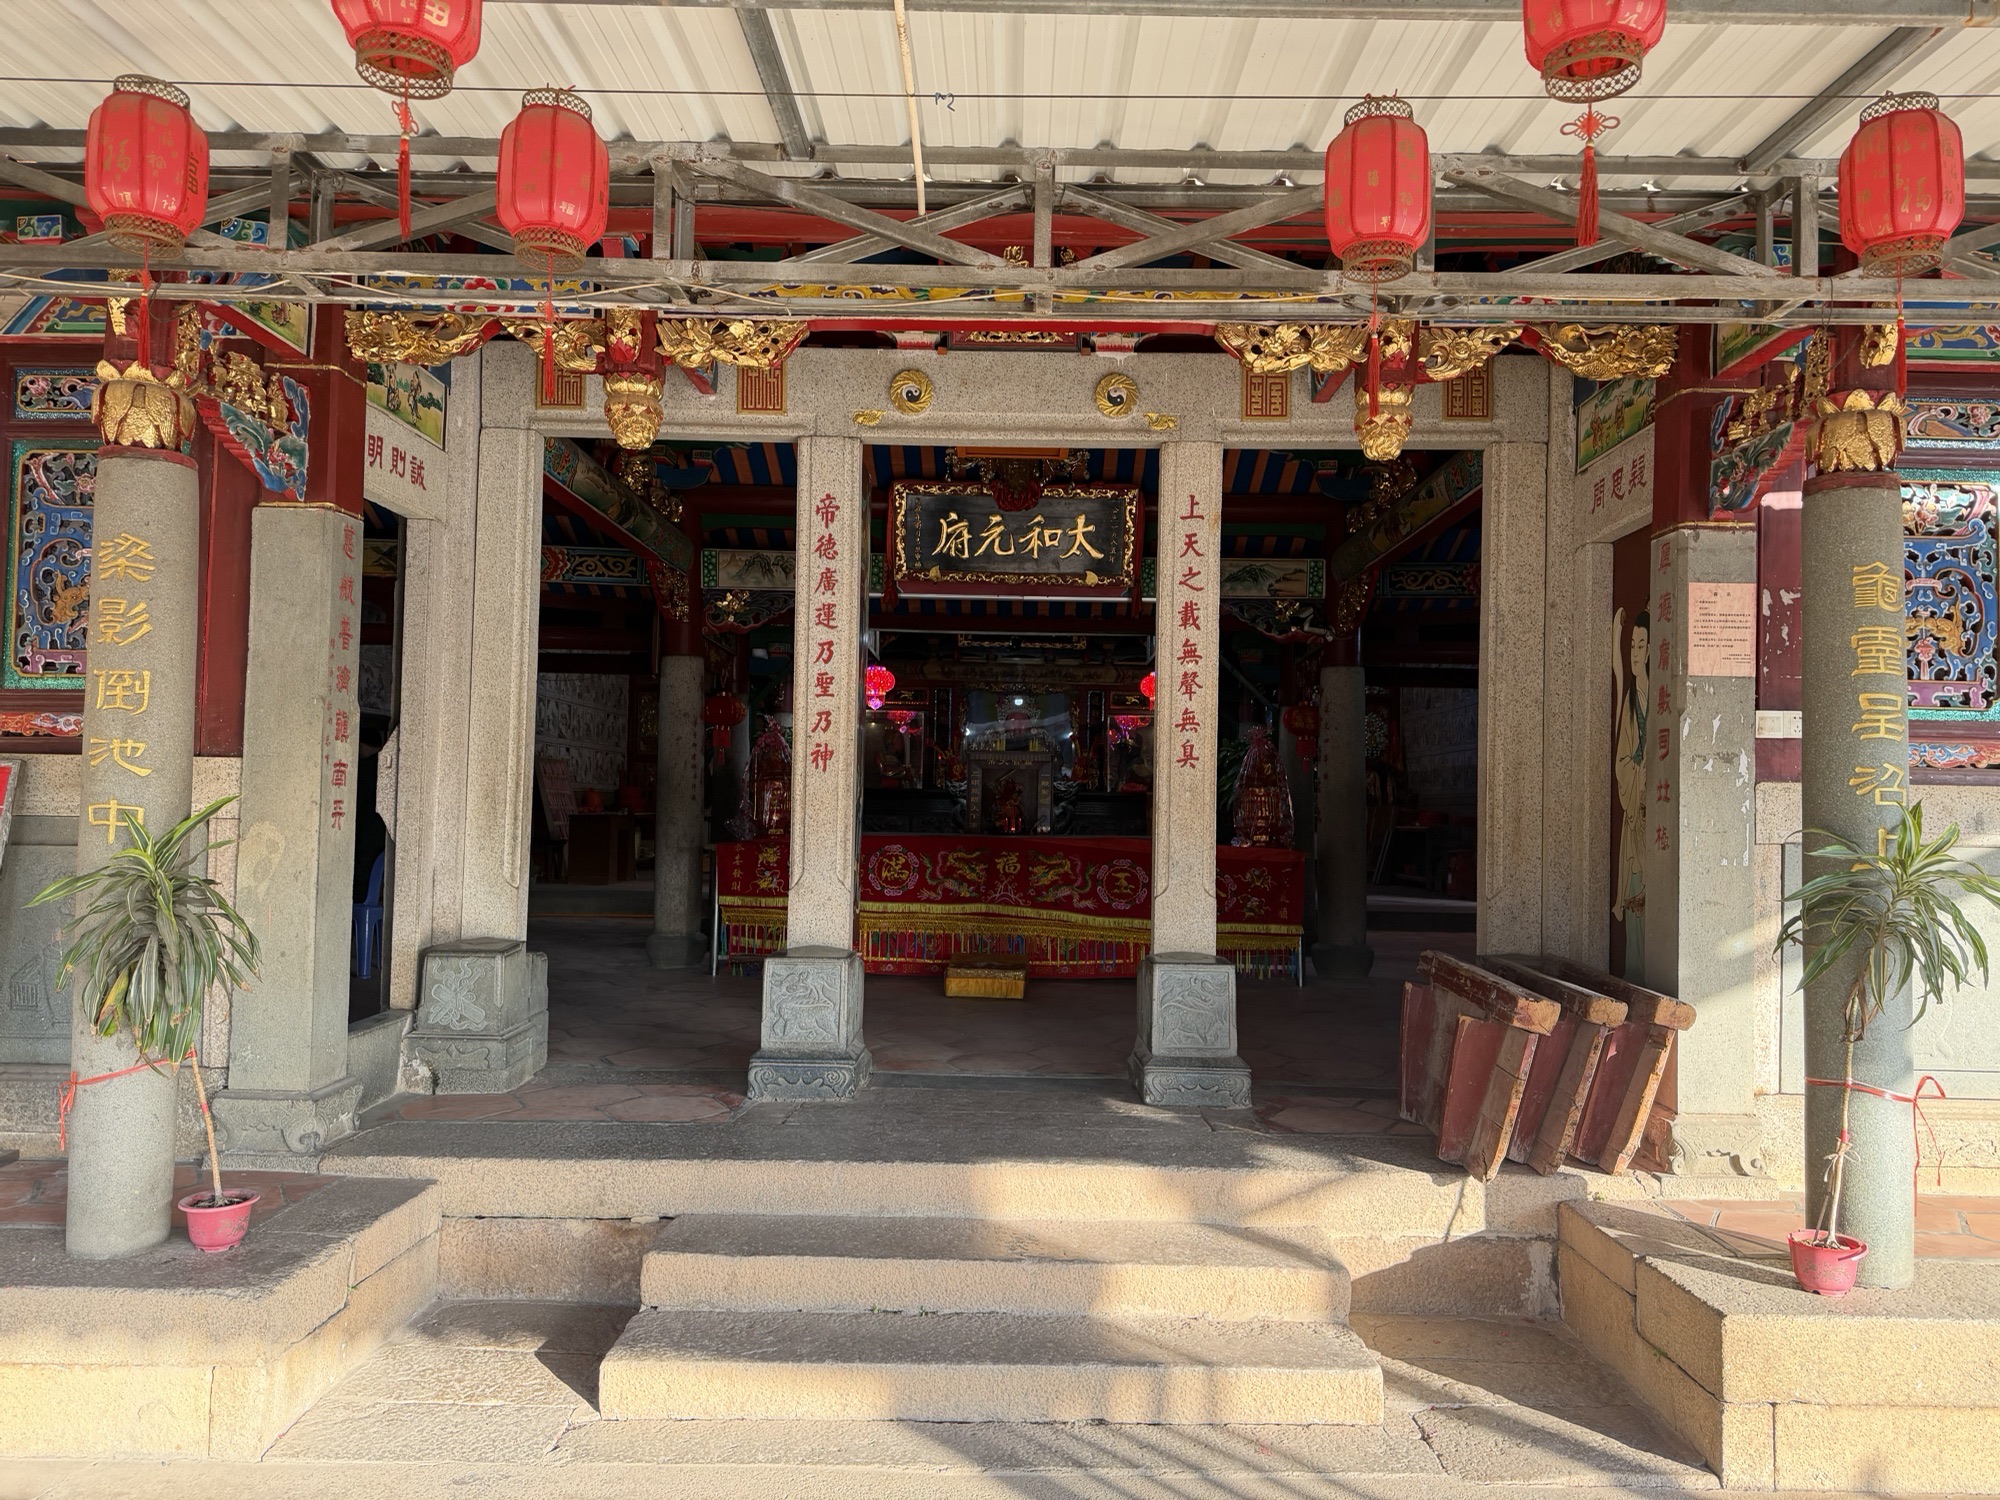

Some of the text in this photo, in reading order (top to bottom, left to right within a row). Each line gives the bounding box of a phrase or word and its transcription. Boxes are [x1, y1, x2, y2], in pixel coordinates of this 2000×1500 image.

[932, 510, 1104, 560] 太和元府
[88, 531, 156, 845] 梁影倒池中
[810, 491, 840, 772] 帝德廣運乃聖乃神
[994, 851, 1021, 875] 福
